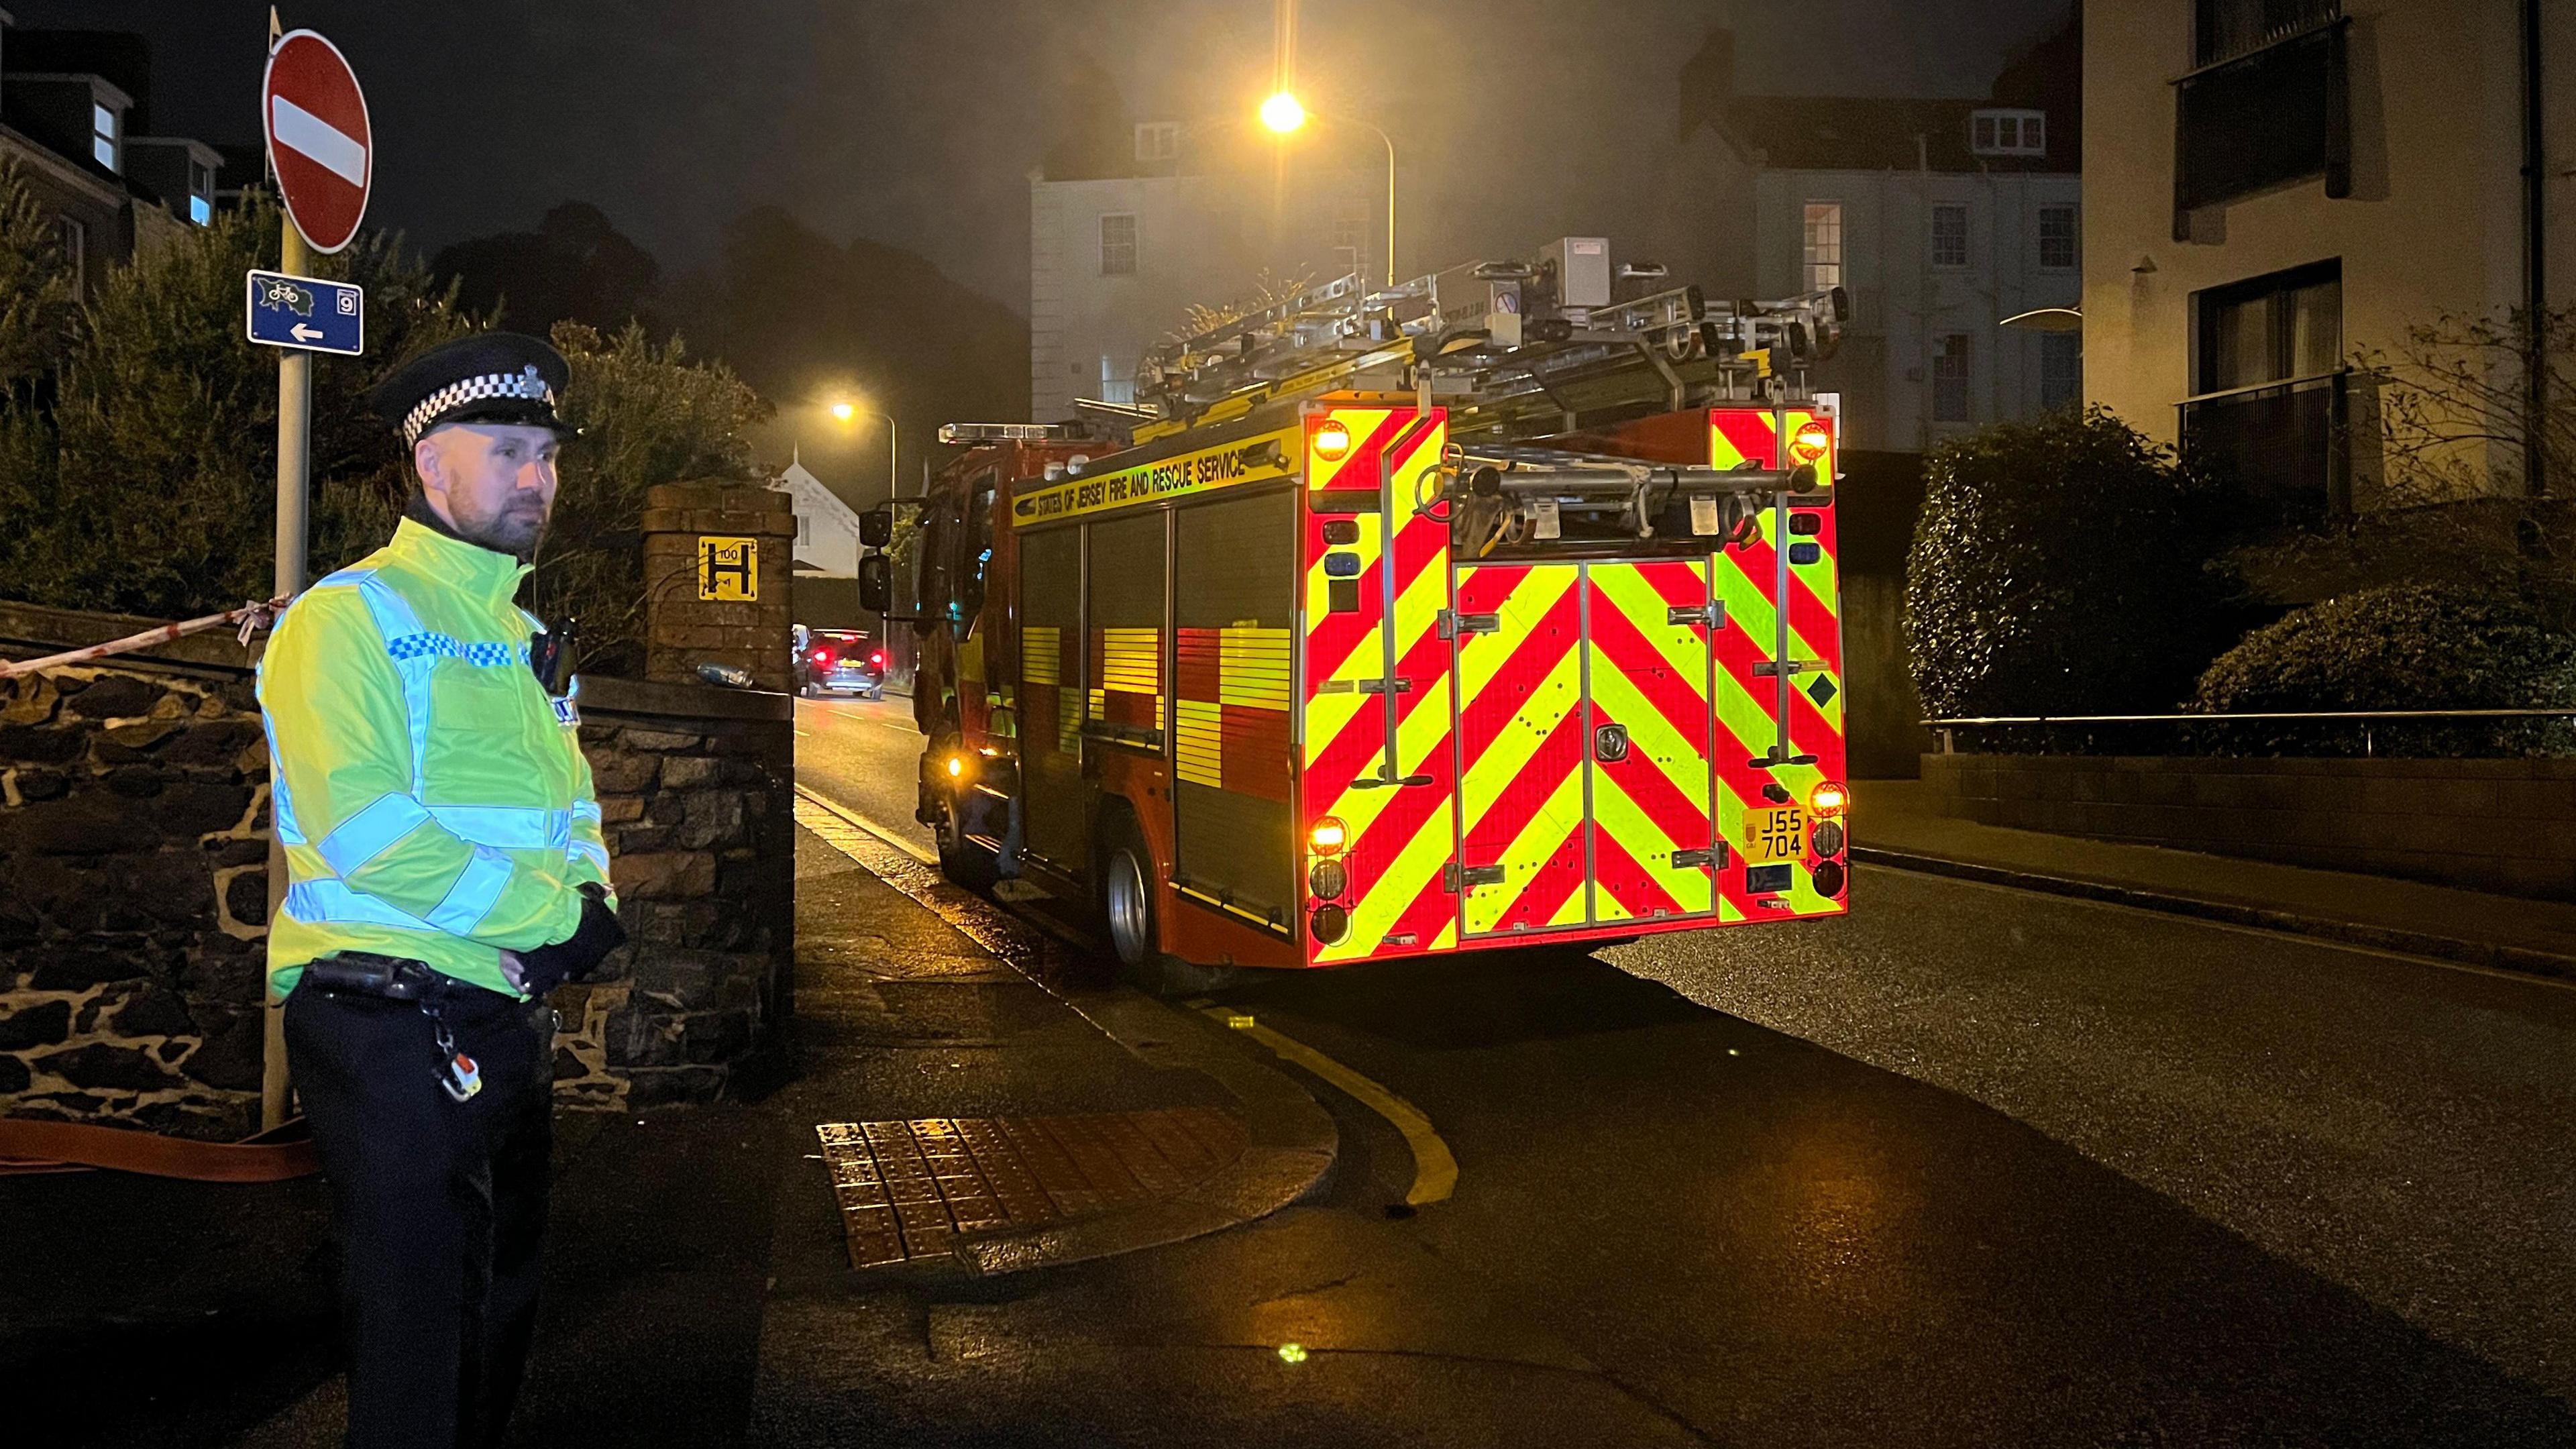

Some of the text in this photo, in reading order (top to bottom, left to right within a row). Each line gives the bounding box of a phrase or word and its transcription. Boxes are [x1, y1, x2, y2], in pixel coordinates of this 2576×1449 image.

[340, 297, 353, 312] 9
[1038, 448, 1245, 516] STATES OF JERSEY FIRE AND RESCUE SERVICE
[720, 549, 738, 560] 100
[708, 543, 749, 594] H
[1762, 810, 1801, 834] J55
[1762, 835, 1801, 859] 704
